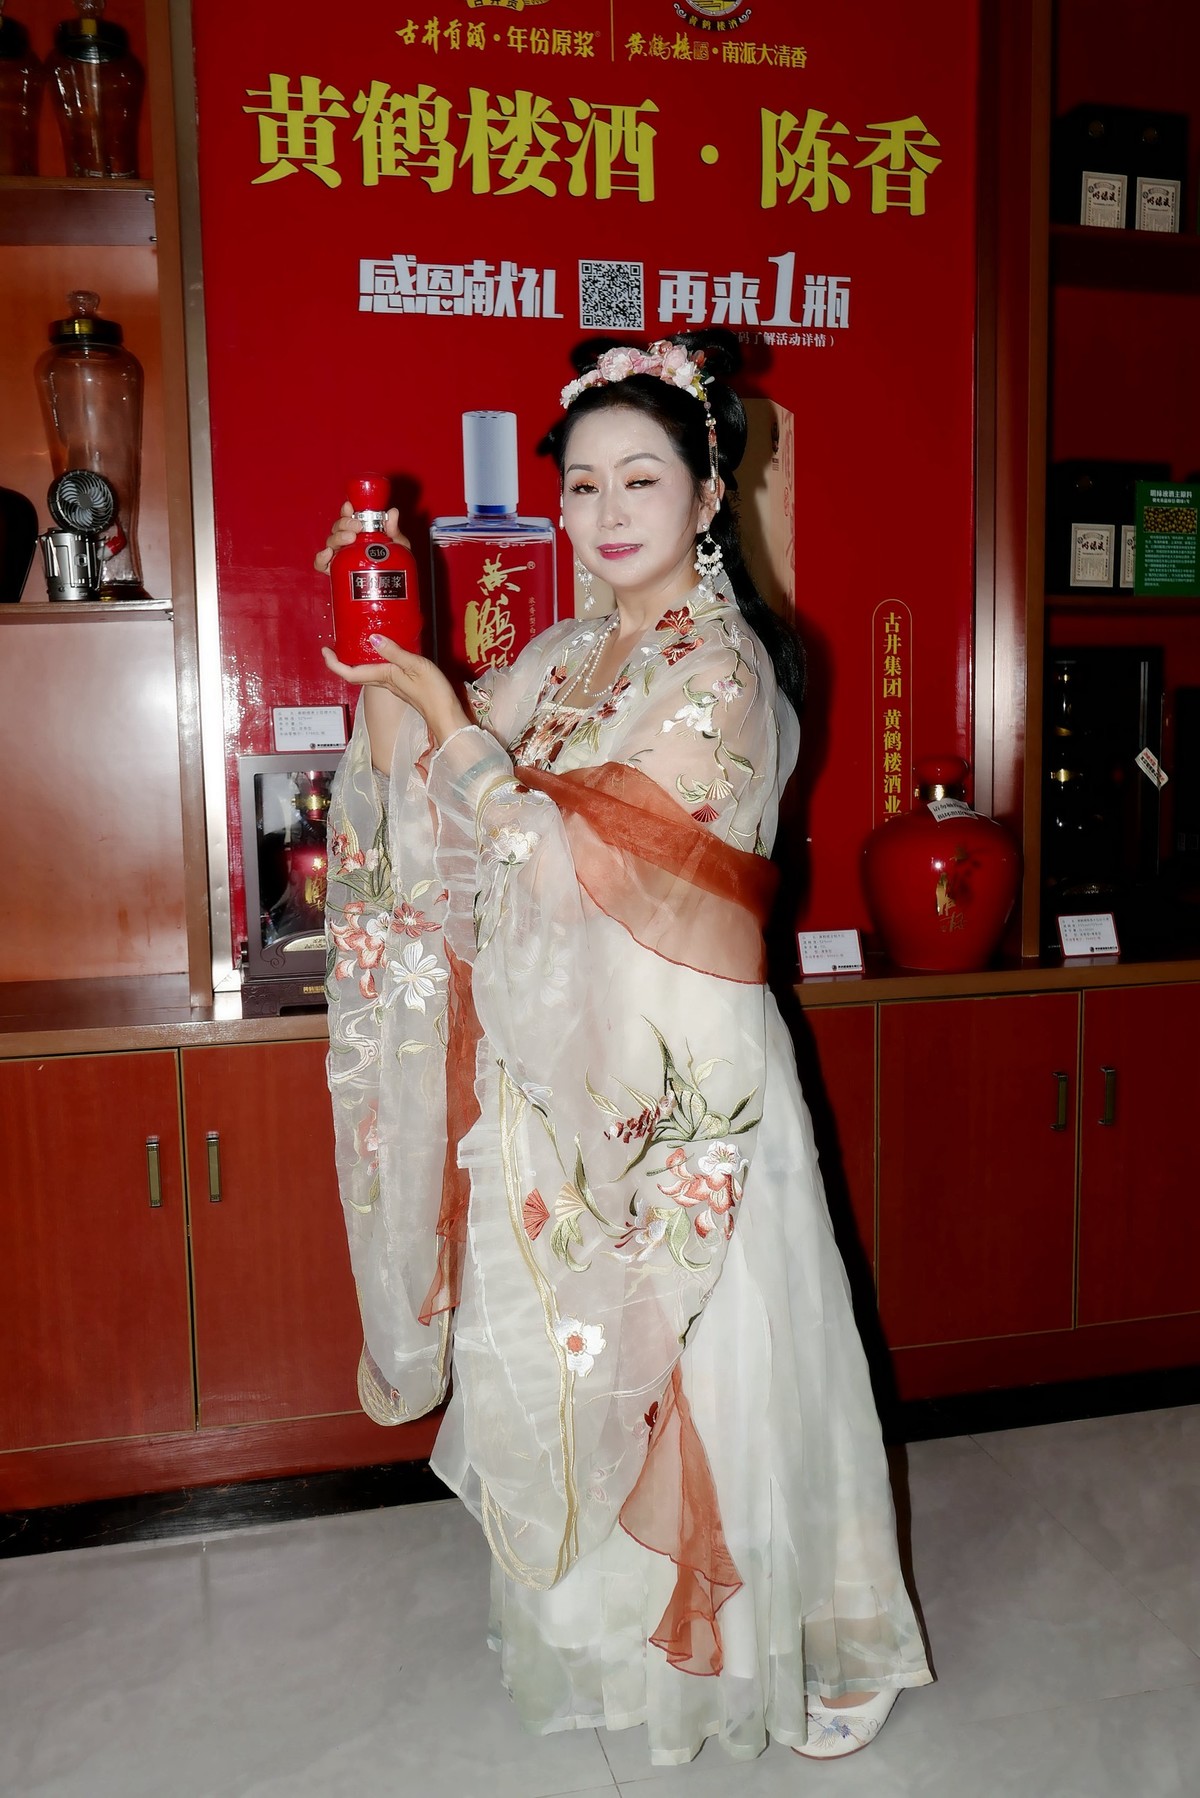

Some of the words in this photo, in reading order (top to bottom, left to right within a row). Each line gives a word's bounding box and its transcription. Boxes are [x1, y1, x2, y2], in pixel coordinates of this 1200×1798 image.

[242, 73, 660, 203] 黄鹤楼酒
[759, 106, 943, 217] 陈香
[358, 254, 564, 319] 感恩献礼
[657, 251, 852, 329] 再来1瓶
[355, 575, 403, 590] 年份原浆
[882, 611, 903, 699] 古井集团
[882, 708, 903, 822] 黄鹤楼酒业
